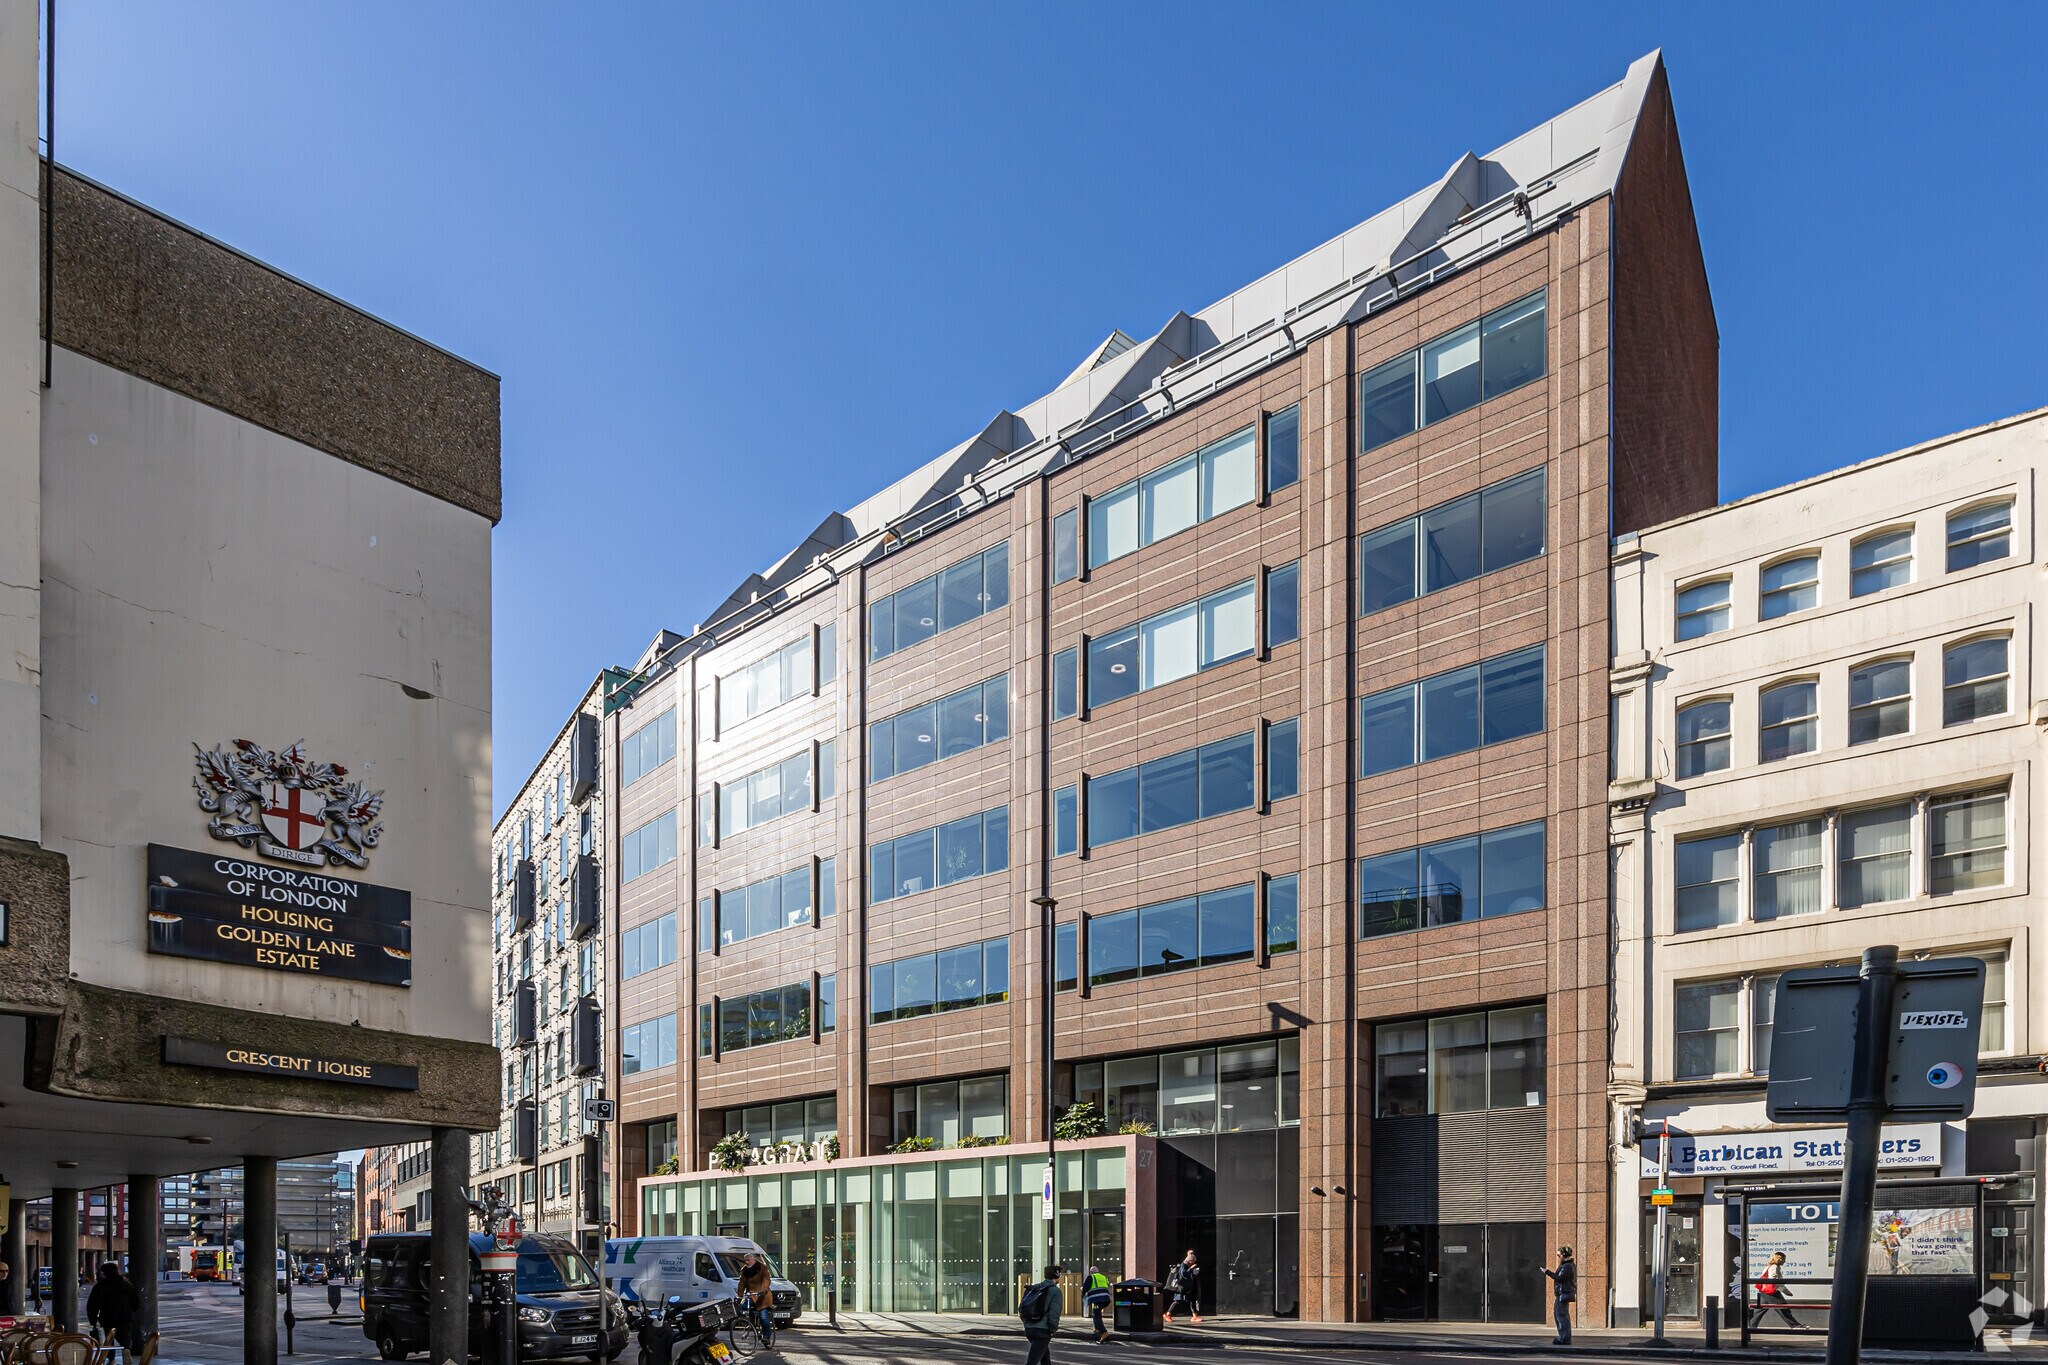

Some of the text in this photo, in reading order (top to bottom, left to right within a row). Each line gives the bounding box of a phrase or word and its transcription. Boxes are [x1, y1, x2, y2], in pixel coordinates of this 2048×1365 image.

[271, 847, 313, 862] DIRIGE
[328, 841, 353, 859] NOS
[214, 859, 358, 898] CORPORATION
[227, 880, 347, 913] OF LONDON
[241, 904, 334, 932] HOUSING
[217, 924, 356, 958] GOLDEN LANE
[256, 948, 320, 970] ESTATE
[226, 1050, 372, 1079] CRESCENT HOUSE
[708, 1140, 831, 1171] PAGRAM
[1139, 1150, 1153, 1168] 27
[1682, 1138, 1921, 1163] Barbican Staters
[1885, 1155, 1935, 1164] 01-250-1921
[1786, 1204, 1820, 1220] TO
